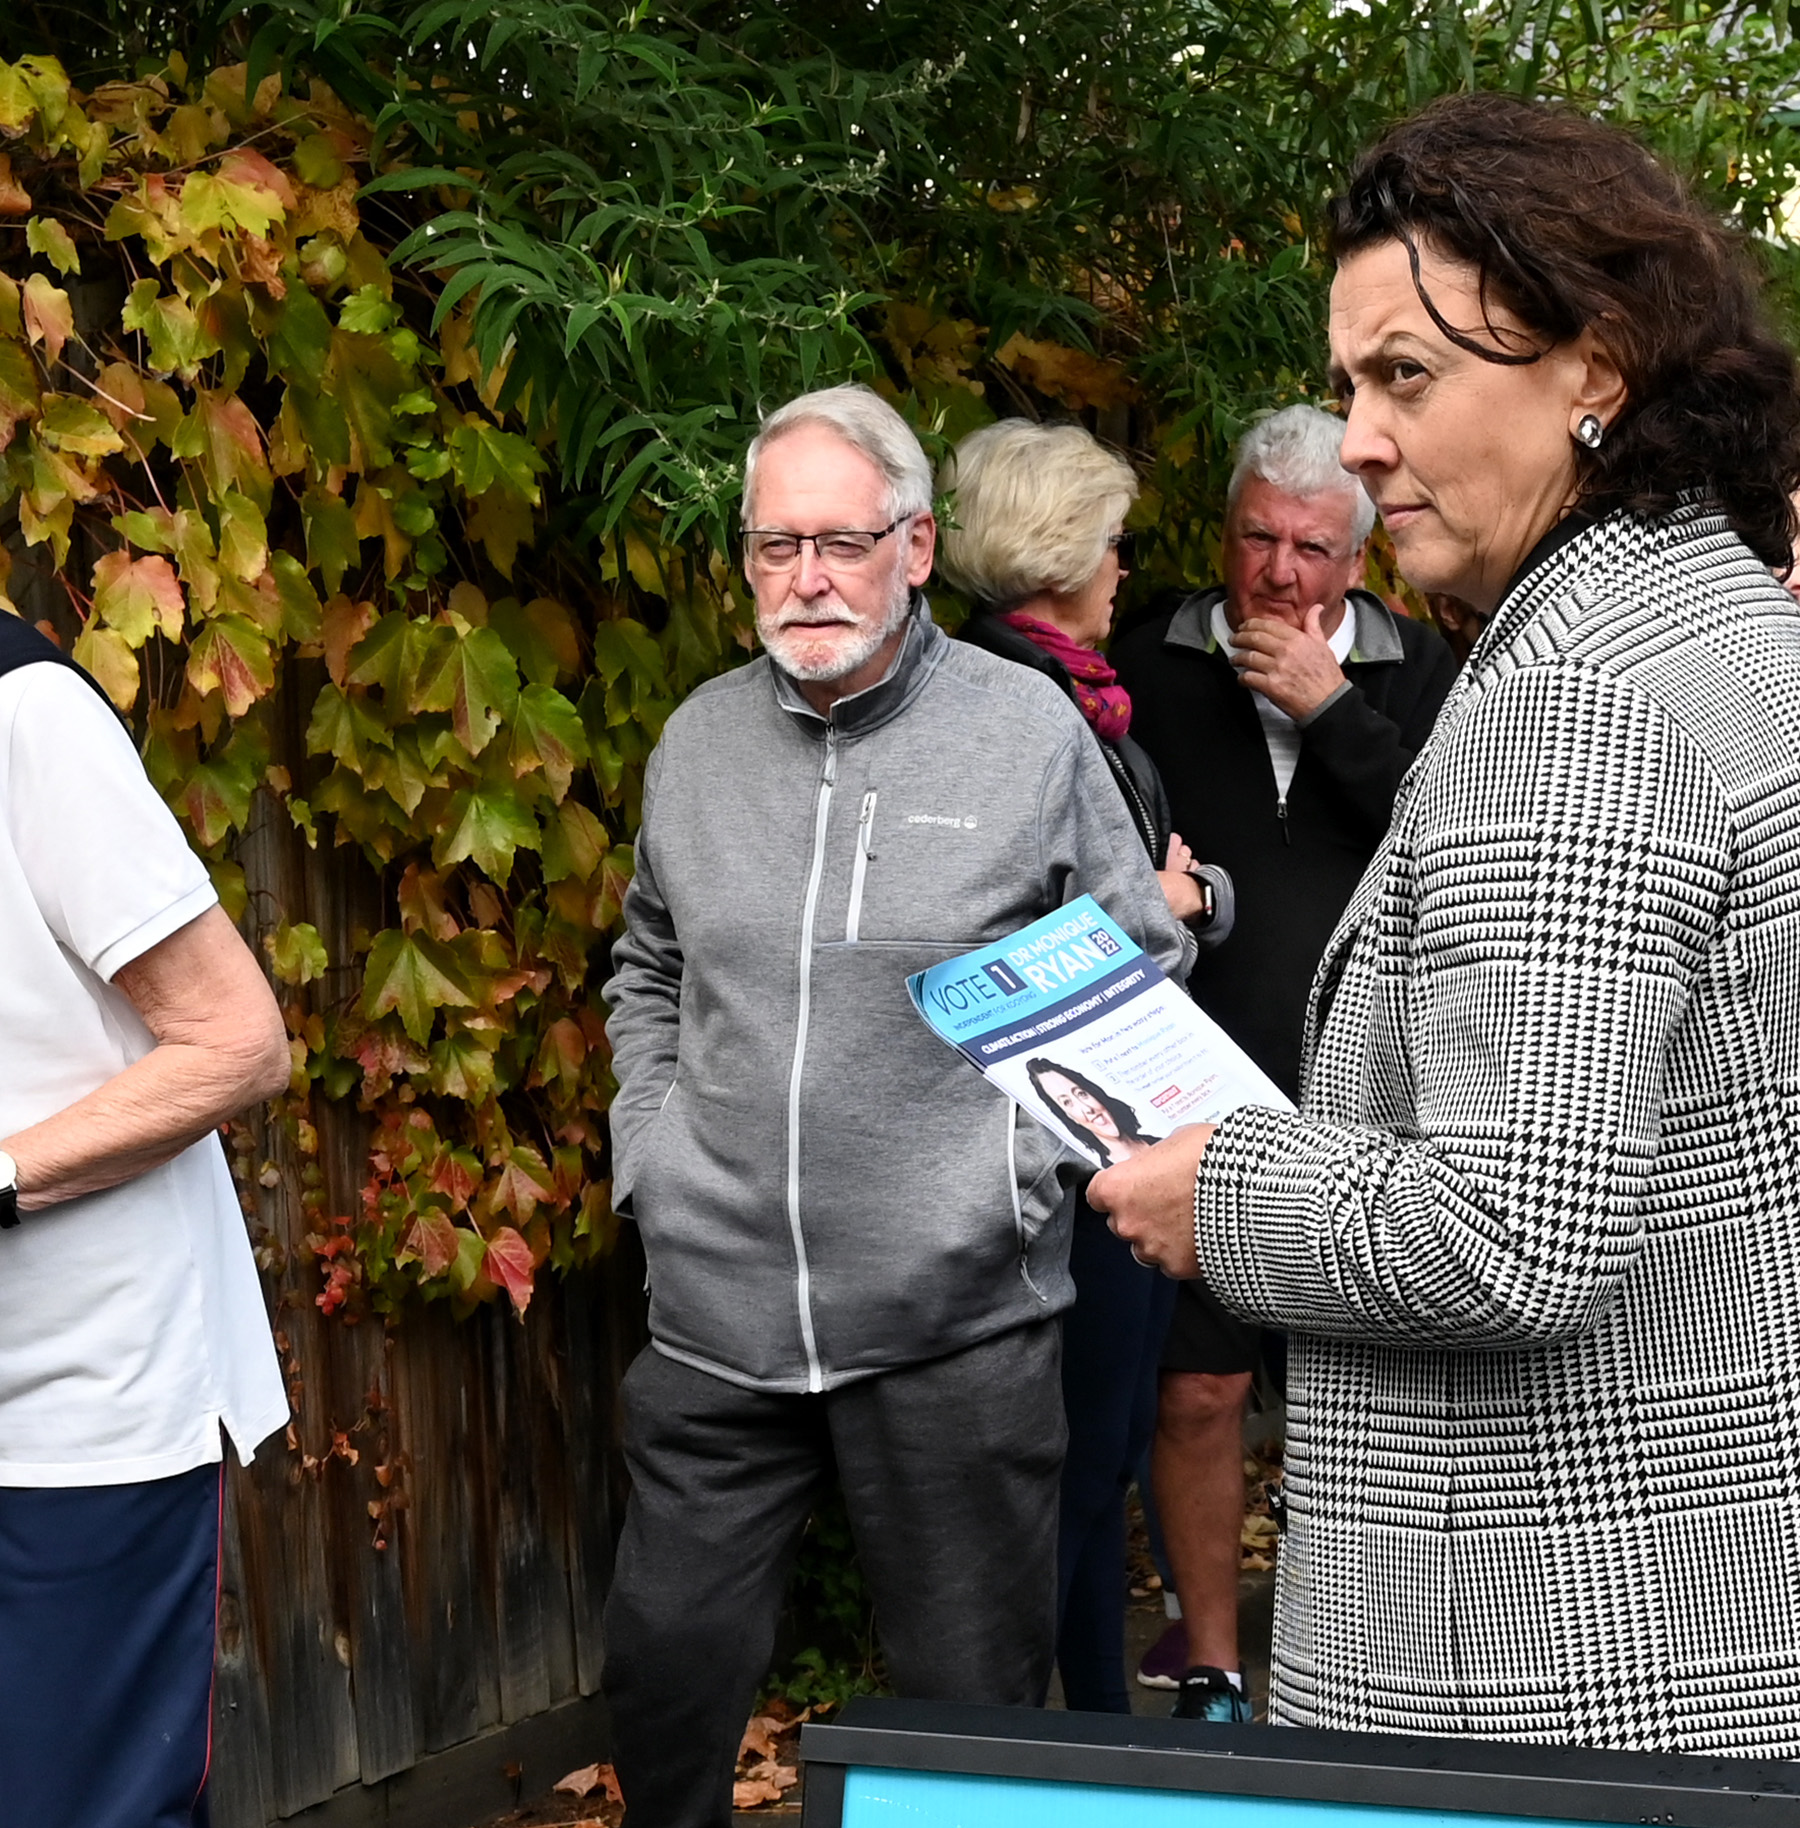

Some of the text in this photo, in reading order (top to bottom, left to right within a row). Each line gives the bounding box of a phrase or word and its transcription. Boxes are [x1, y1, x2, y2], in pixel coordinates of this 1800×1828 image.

[1007, 912, 1098, 967] DR MONIQUE
[1090, 928, 1110, 944] 20
[1100, 940, 1121, 957] 22
[930, 965, 1017, 1016] VOTE 1
[1023, 936, 1107, 994] RYAN
[953, 1008, 996, 1031] INDEPENDENT
[1037, 1013, 1068, 1036] STRONG
[1065, 993, 1102, 1021] ECONOMY
[1105, 968, 1146, 1002] INTEGRITY
